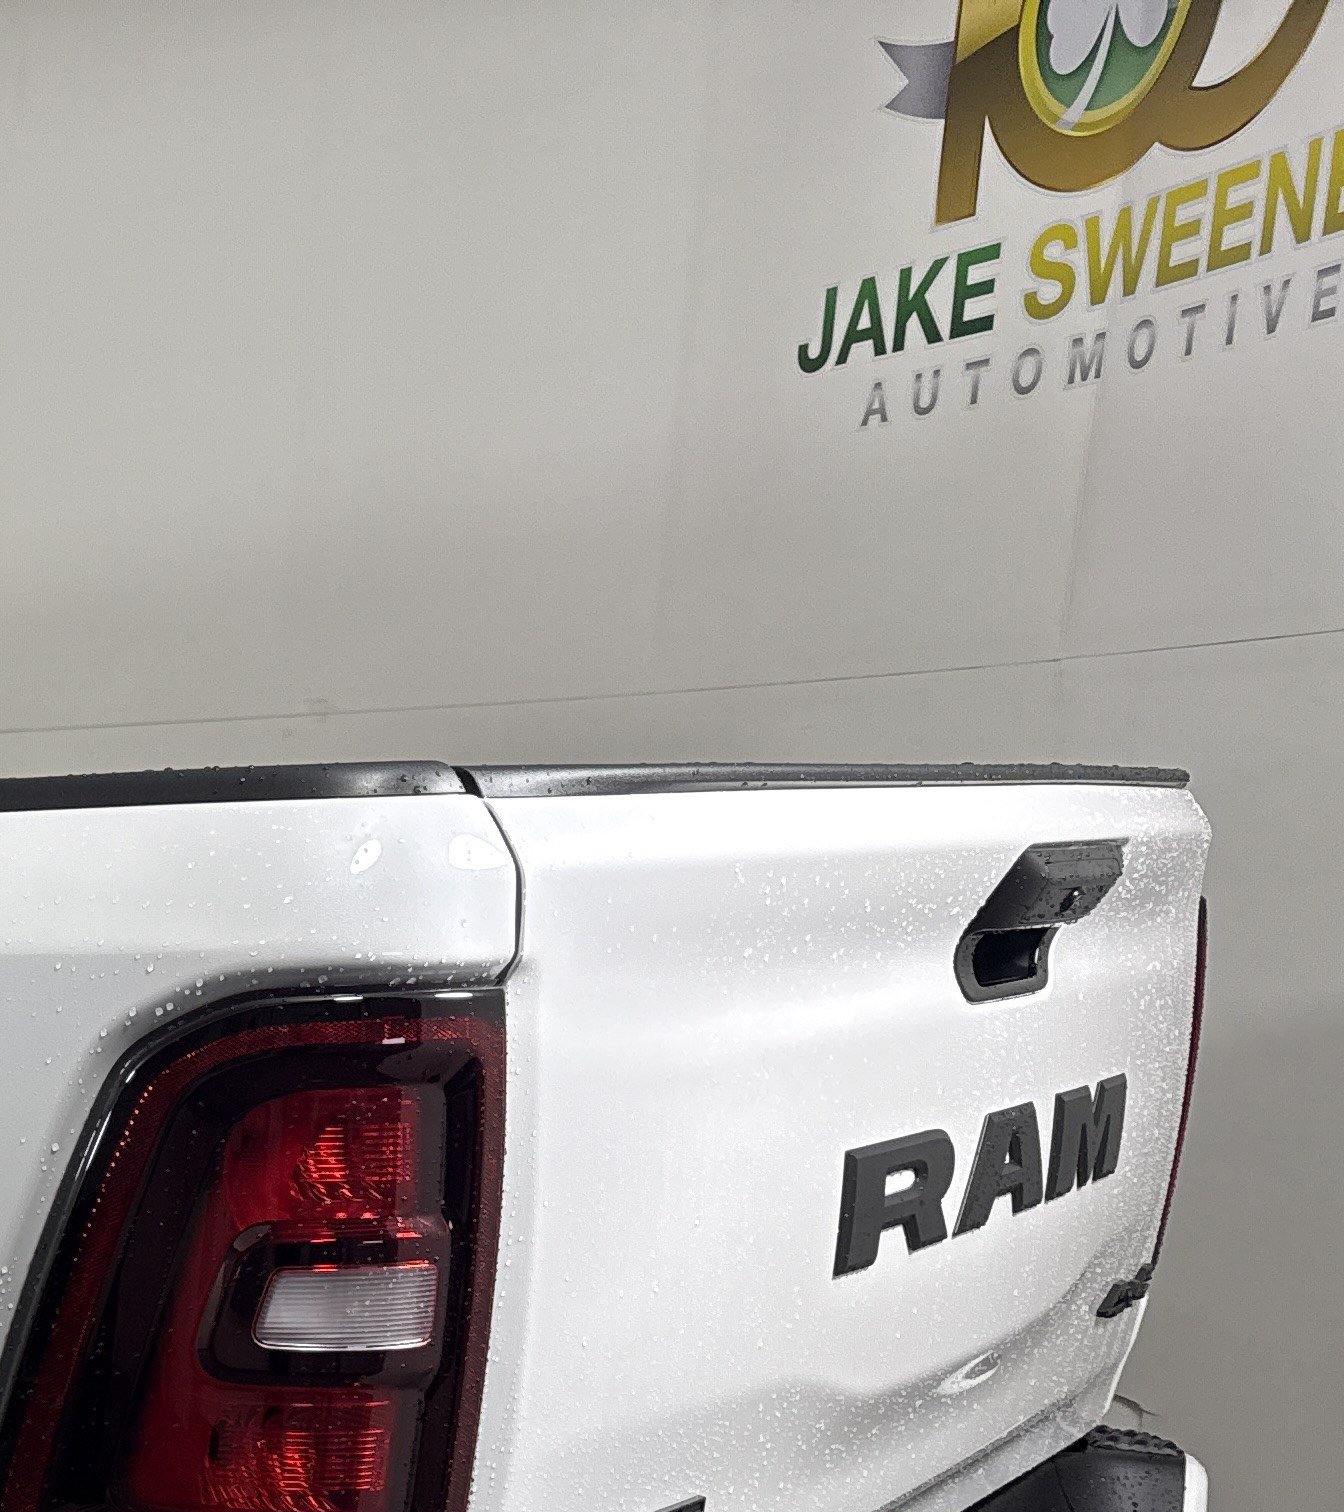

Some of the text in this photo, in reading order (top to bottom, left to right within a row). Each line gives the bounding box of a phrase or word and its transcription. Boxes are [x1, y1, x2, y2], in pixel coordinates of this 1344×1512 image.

[797, 241, 1002, 374] JAKE
[859, 262, 1343, 429] AUTOMOTIVE
[833, 1072, 1127, 1280] RAM
